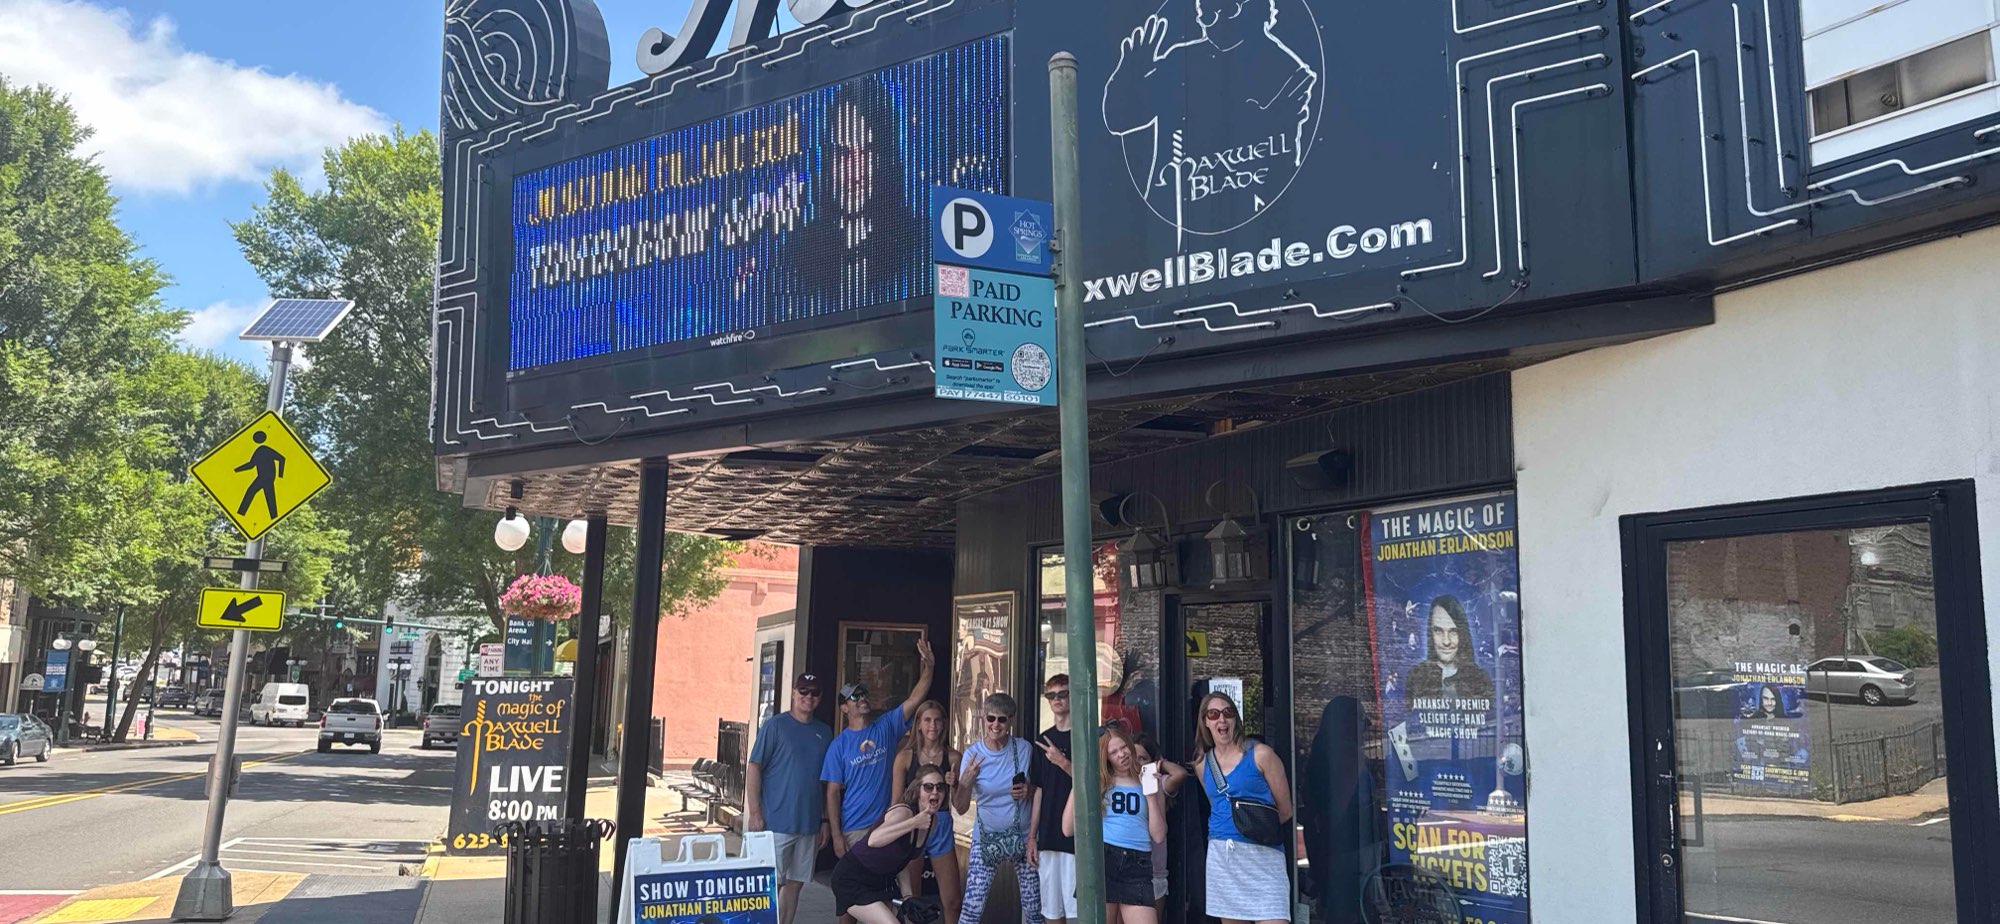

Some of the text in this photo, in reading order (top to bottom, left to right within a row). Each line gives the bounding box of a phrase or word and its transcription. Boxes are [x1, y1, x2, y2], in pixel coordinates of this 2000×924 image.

[954, 203, 986, 250] P
[1013, 227, 1043, 238] SPRINGS
[1020, 220, 1036, 230] HOT
[1083, 217, 1433, 303] xwellBlade.Com
[972, 279, 1020, 301] PAID
[950, 301, 1042, 328] PARKING
[710, 333, 743, 347] watchfire
[939, 388, 960, 396] PAY
[966, 390, 1000, 399] 77447
[1381, 502, 1505, 539] THE MAGIC OF
[1377, 529, 1514, 561] JONATHAN ERLANDSON
[507, 637, 533, 647] City Hal
[1735, 662, 1801, 674] THE MAGIC OF
[472, 680, 554, 695] TONIGHT
[1732, 674, 1805, 685] JONATHAN ERLANDSON
[528, 693, 543, 702] the
[1413, 699, 1490, 710] ARKANSAS' PREMIER
[497, 699, 566, 719] magic of
[1418, 712, 1486, 725] SLEIGHT-OF-HAND
[1427, 728, 1478, 739] MAGIC SHOW
[489, 765, 564, 793] LIVE
[488, 799, 557, 821] 8:00 PM
[1111, 791, 1140, 815] 80
[1392, 822, 1485, 860] SCAN FOR
[1409, 853, 1487, 892] TICKETS
[640, 875, 771, 901] SHOW TONIGHT!
[641, 896, 770, 919] JONATHAN ERLANDSON
